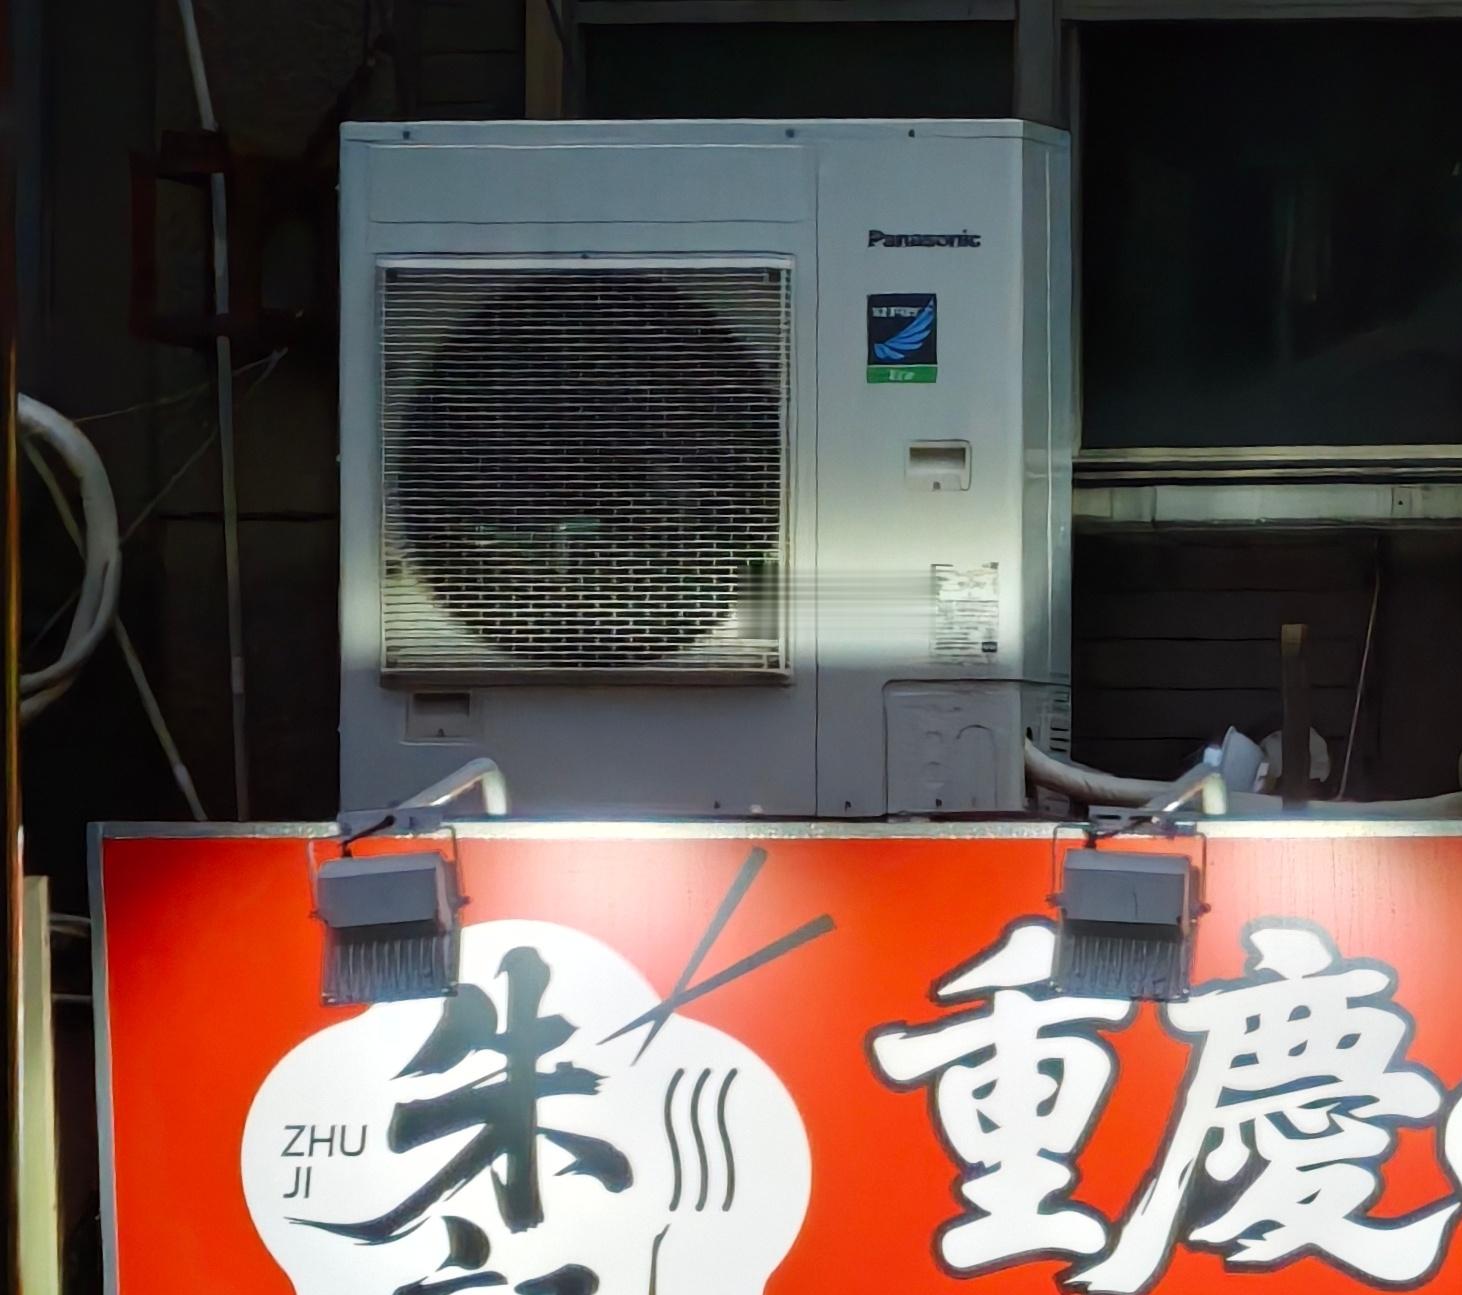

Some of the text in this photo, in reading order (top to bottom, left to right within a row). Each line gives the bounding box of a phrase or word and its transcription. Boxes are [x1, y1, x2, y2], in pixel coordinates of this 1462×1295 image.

[868, 229, 981, 248] Panasonic
[281, 1124, 368, 1158] ZHU
[283, 1166, 312, 1200] JI
